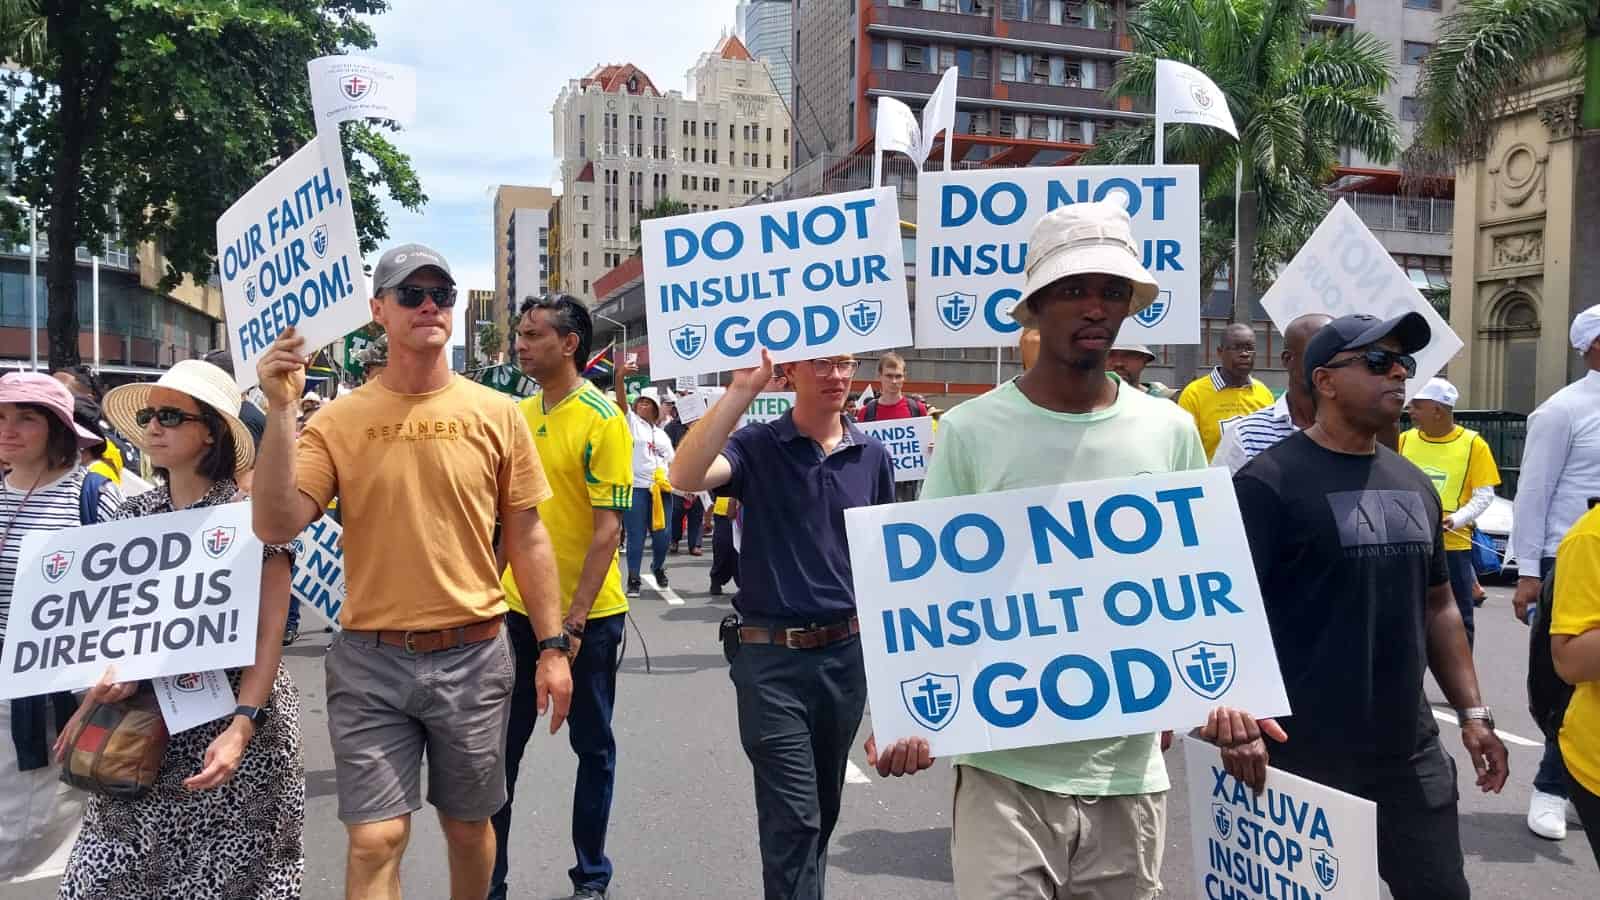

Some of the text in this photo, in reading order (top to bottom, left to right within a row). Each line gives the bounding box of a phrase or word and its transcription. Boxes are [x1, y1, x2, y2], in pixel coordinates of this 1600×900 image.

[223, 167, 343, 281] OUR FAITH,
[664, 196, 876, 268] DO NOT
[940, 181, 1028, 228] DO
[259, 238, 311, 298] OUR
[660, 254, 892, 313] INSULT OUR
[930, 242, 1028, 278] INSU
[238, 255, 354, 361] FREEDOM!
[714, 304, 841, 358] GOD
[367, 420, 472, 439] REFINERY
[865, 425, 916, 441] ANDS
[889, 441, 921, 455] THE
[81, 532, 192, 582] GOD
[882, 486, 1205, 583] DO NOT
[31, 569, 232, 631] GIVES US
[881, 571, 1244, 654] INSULT OUR
[13, 609, 239, 674] DIRECTION!
[972, 647, 1173, 729] GOD
[1211, 766, 1334, 848] XALUVA
[1236, 816, 1304, 872] STOP
